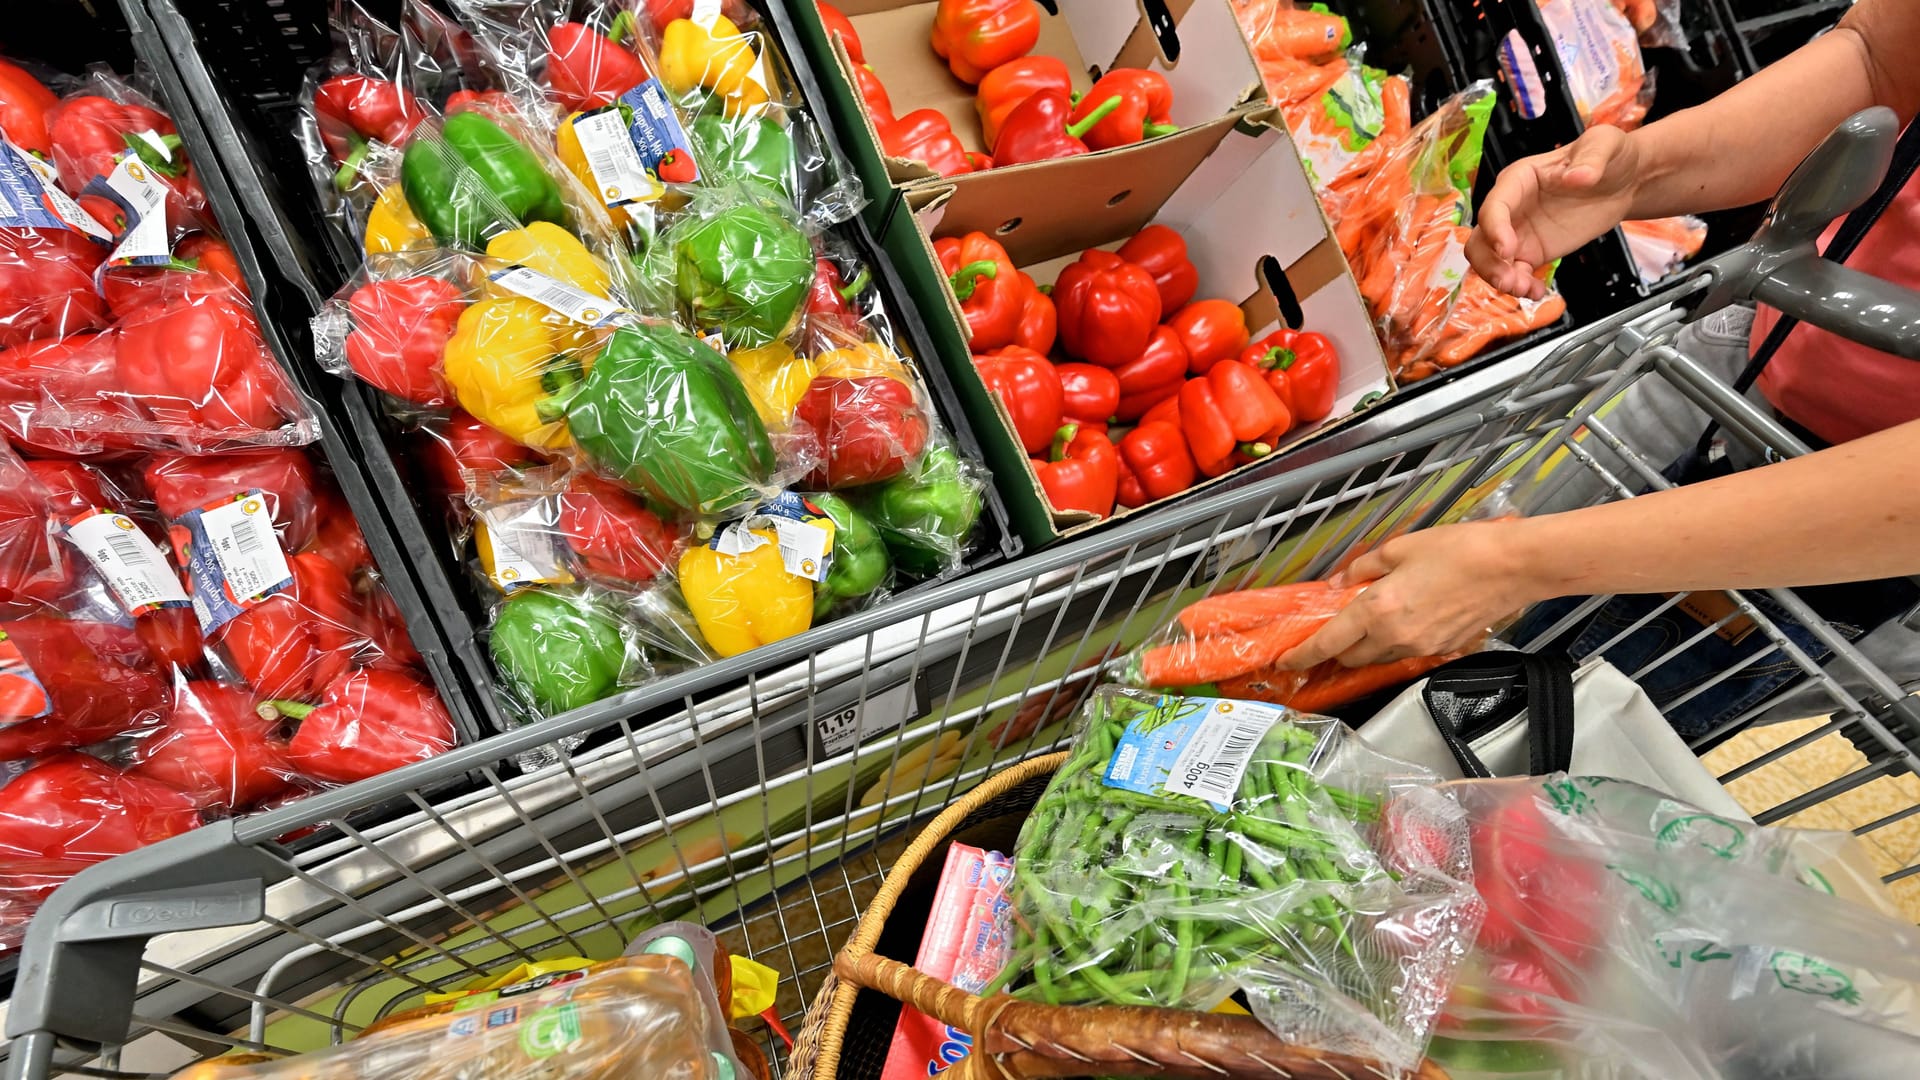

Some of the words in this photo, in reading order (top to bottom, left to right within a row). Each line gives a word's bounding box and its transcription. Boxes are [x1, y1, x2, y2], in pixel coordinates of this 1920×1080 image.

[632, 107, 655, 141] Paprika
[649, 139, 663, 157] Mix
[636, 137, 646, 151] 500
[0, 170, 43, 210] Paprika
[781, 494, 798, 503] Mix
[204, 558, 216, 573] 500
[198, 573, 224, 610] Paprika
[819, 709, 855, 733] 1,19
[1183, 762, 1210, 789] 400g
